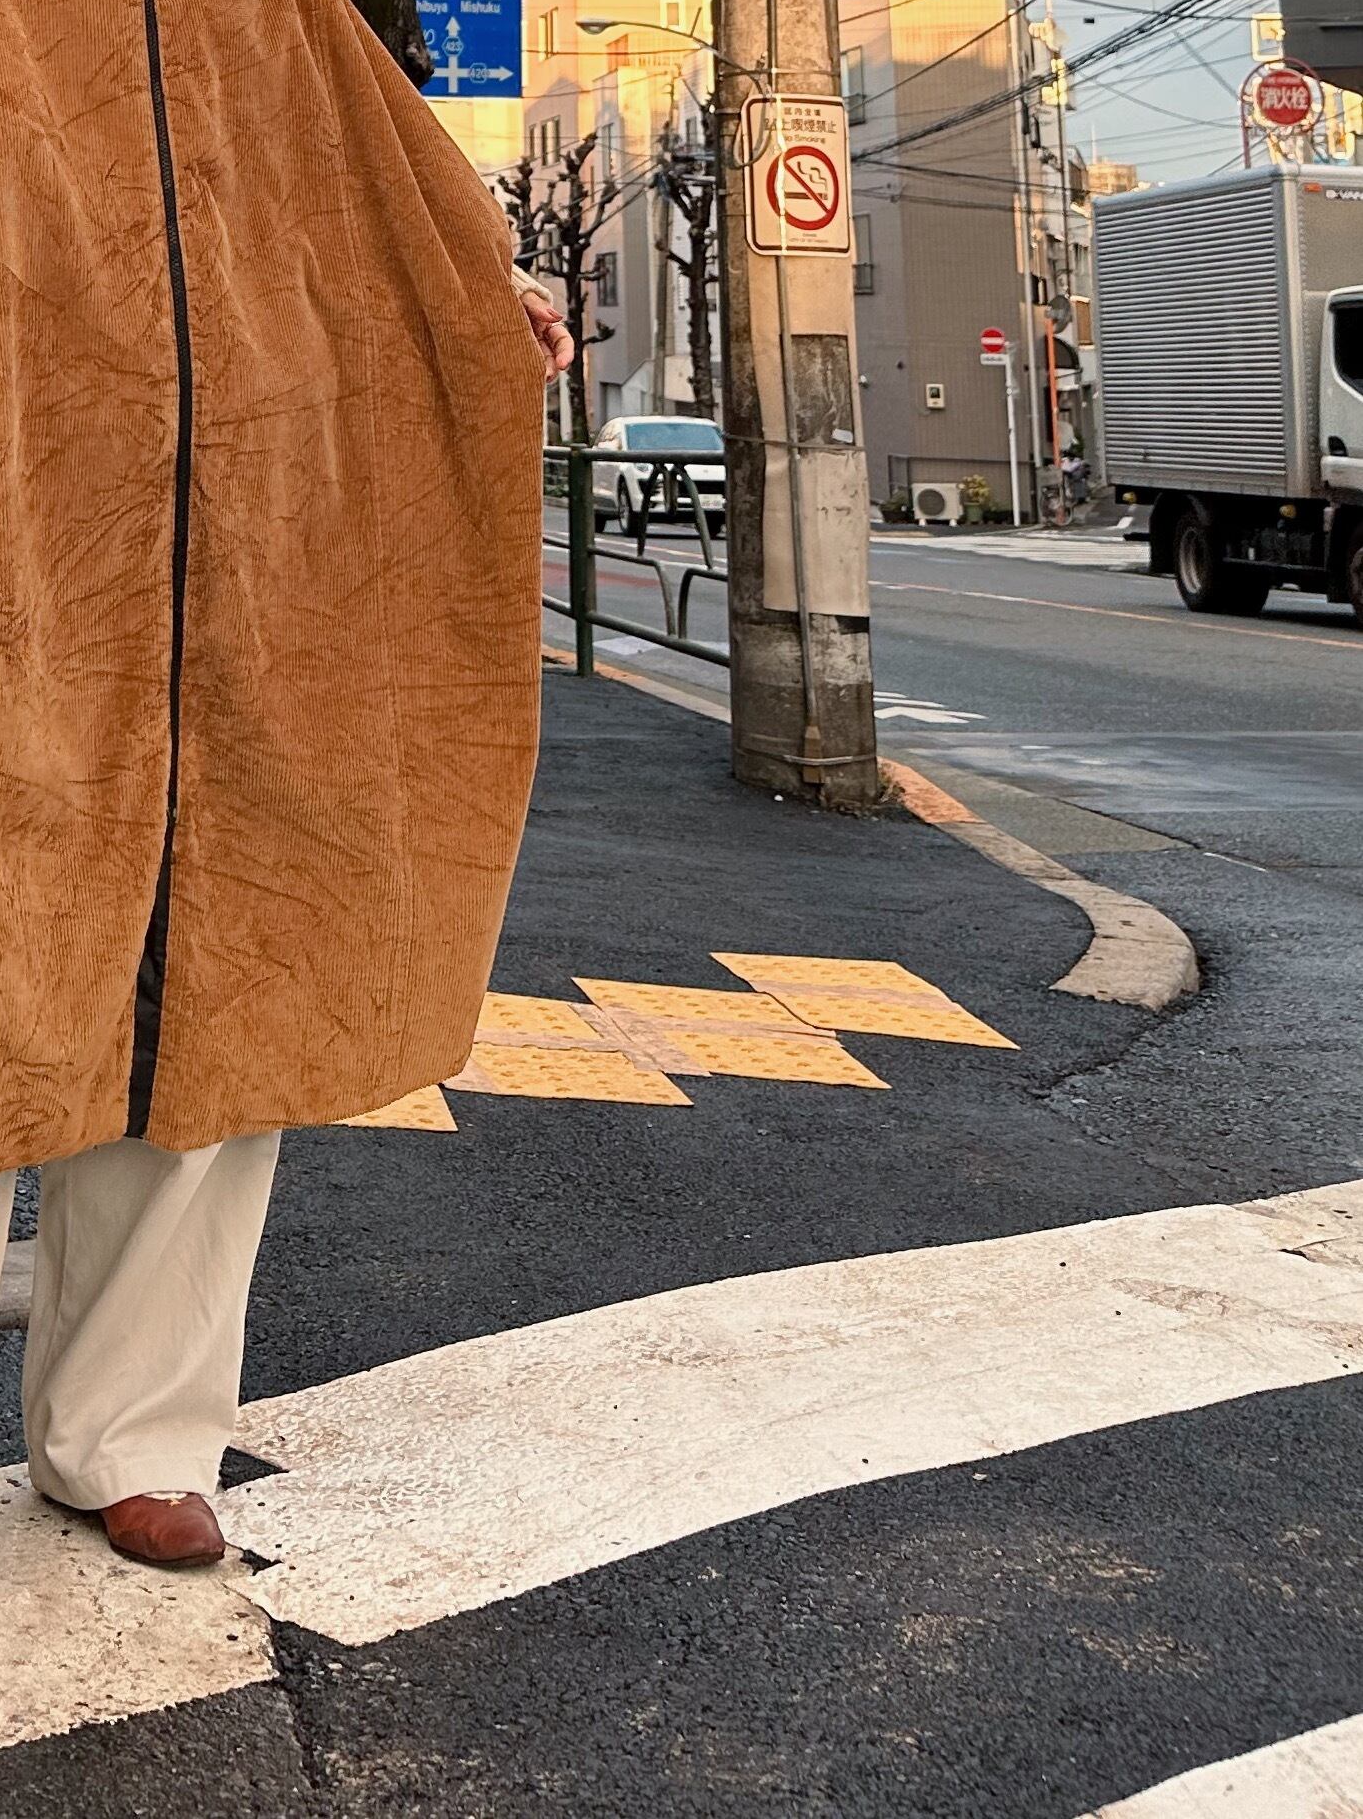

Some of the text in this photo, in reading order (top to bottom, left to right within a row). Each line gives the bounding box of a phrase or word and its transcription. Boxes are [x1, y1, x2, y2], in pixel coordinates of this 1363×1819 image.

[415, 0, 501, 15] hibuya Mishuku
[1260, 86, 1309, 110] 消火栓
